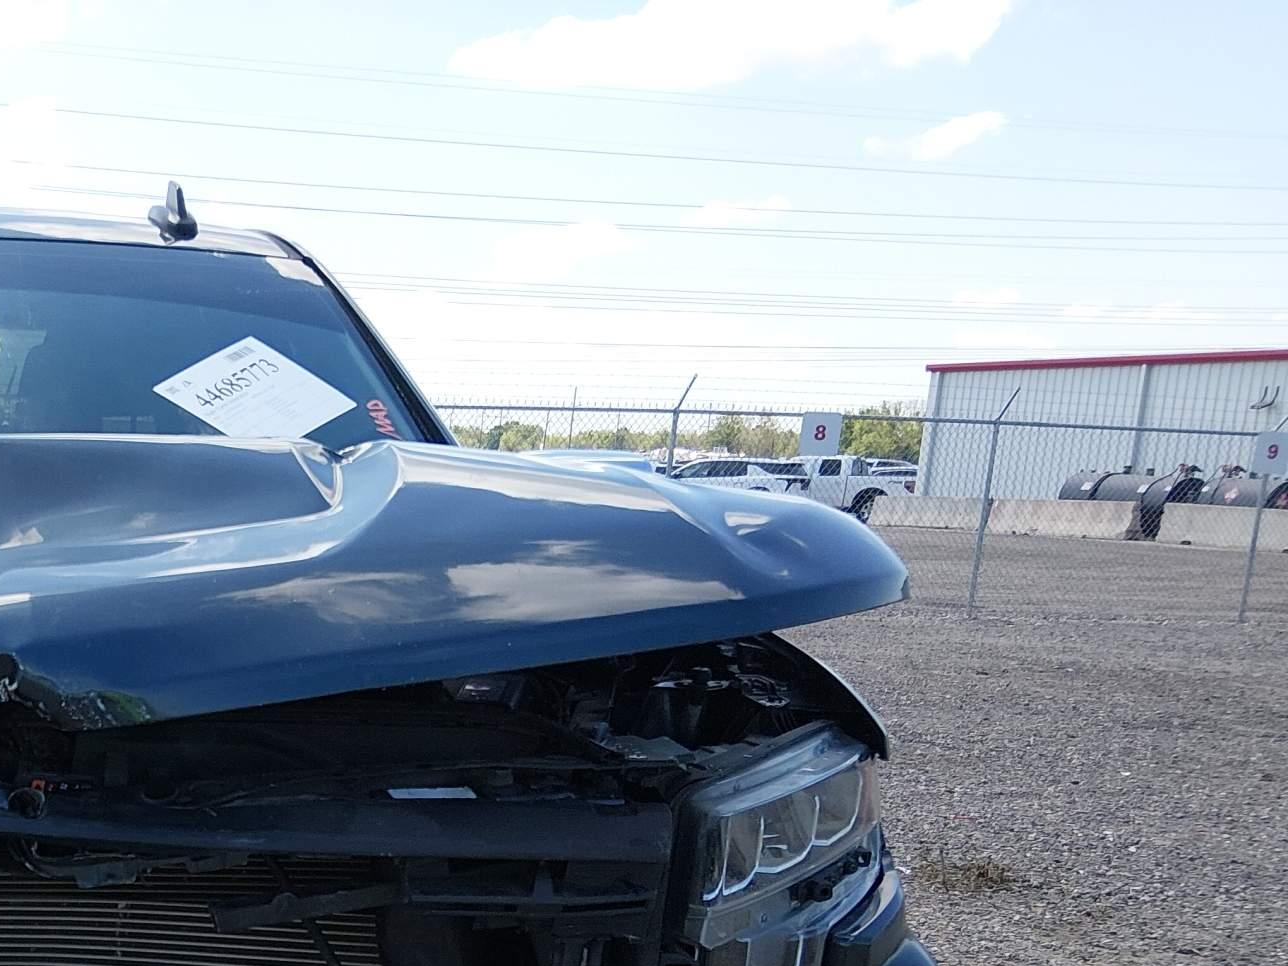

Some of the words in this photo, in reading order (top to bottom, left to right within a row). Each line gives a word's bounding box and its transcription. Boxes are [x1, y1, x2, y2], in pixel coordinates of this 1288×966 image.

[195, 358, 280, 407] 44685773
[814, 424, 827, 441] 8
[1266, 443, 1279, 460] 9
